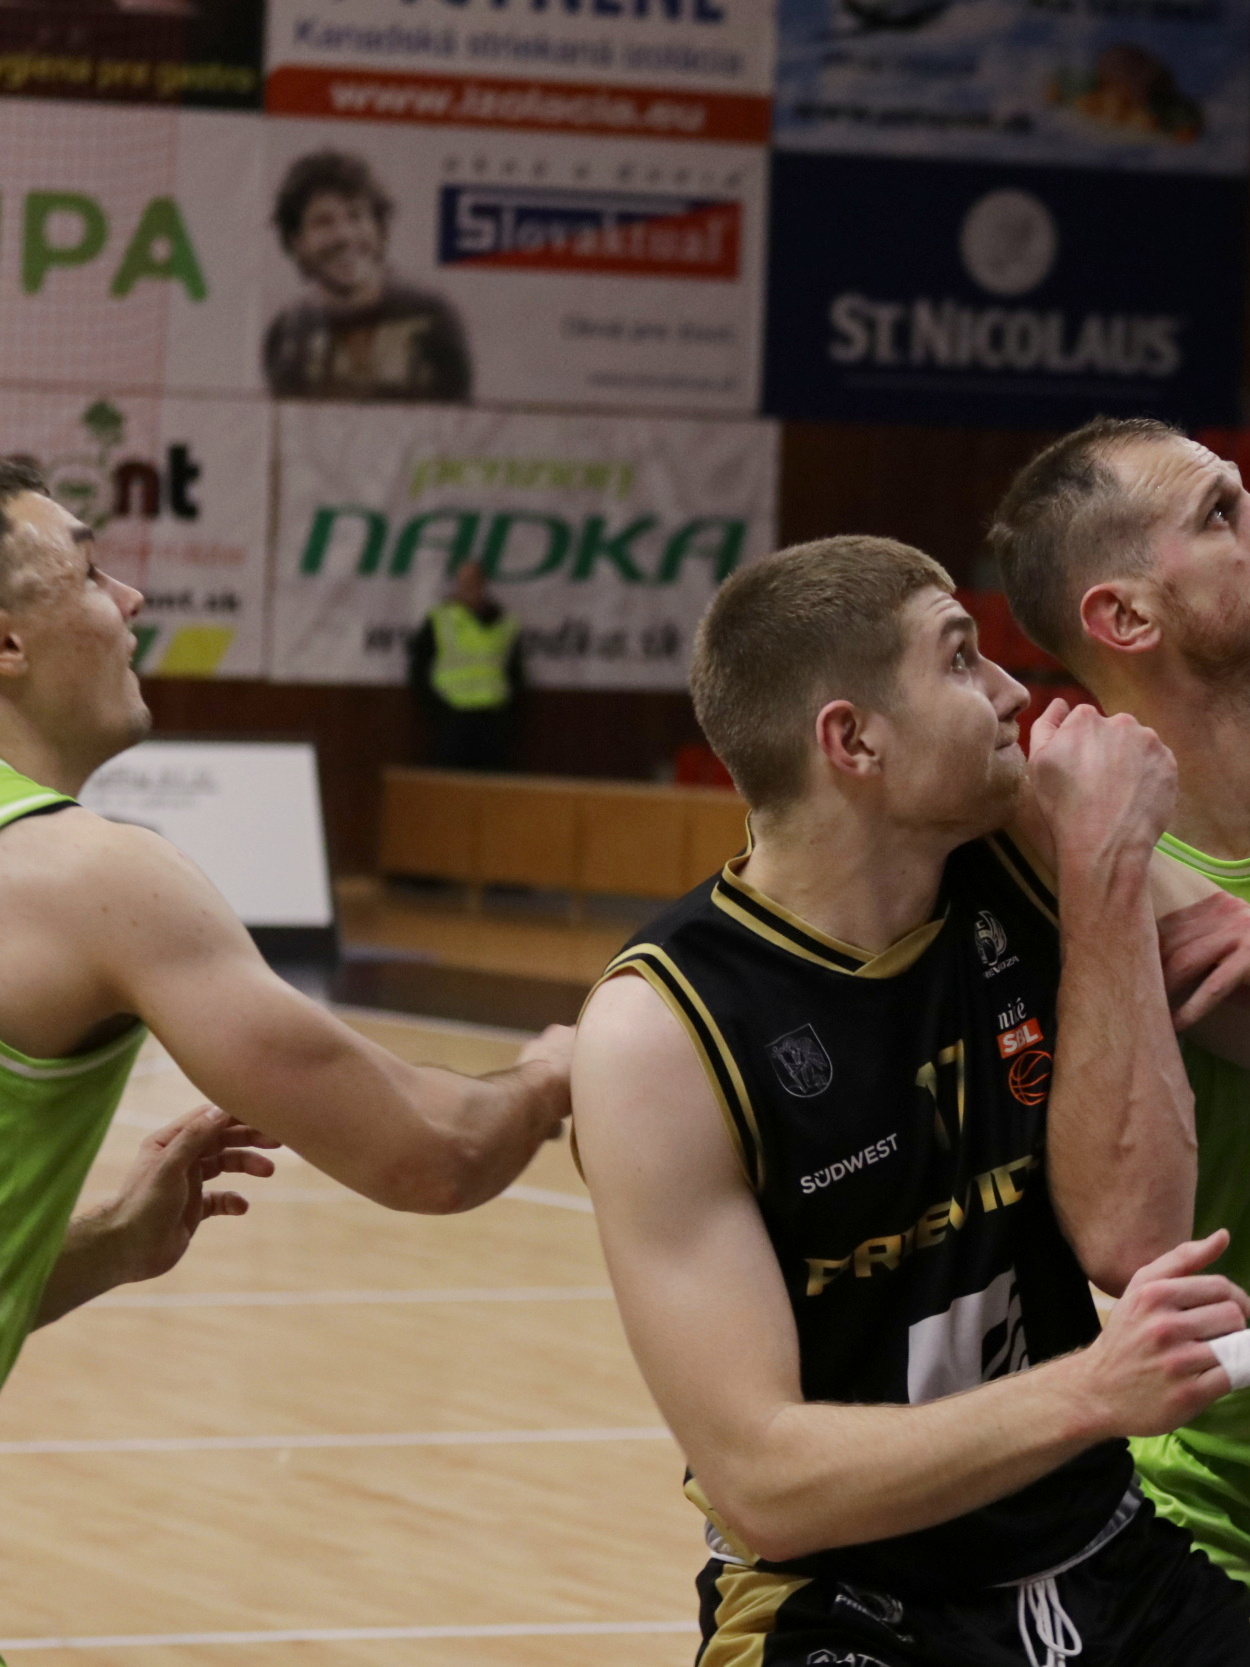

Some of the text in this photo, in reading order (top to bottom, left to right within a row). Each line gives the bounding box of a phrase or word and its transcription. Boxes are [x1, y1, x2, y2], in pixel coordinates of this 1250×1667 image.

[0, 188, 207, 301] PA
[454, 193, 724, 265] Slovaktual
[907, 297, 1183, 378] NICOLAUS
[1002, 1025, 1039, 1053] SBL
[800, 1133, 899, 1195] SÜDWEST
